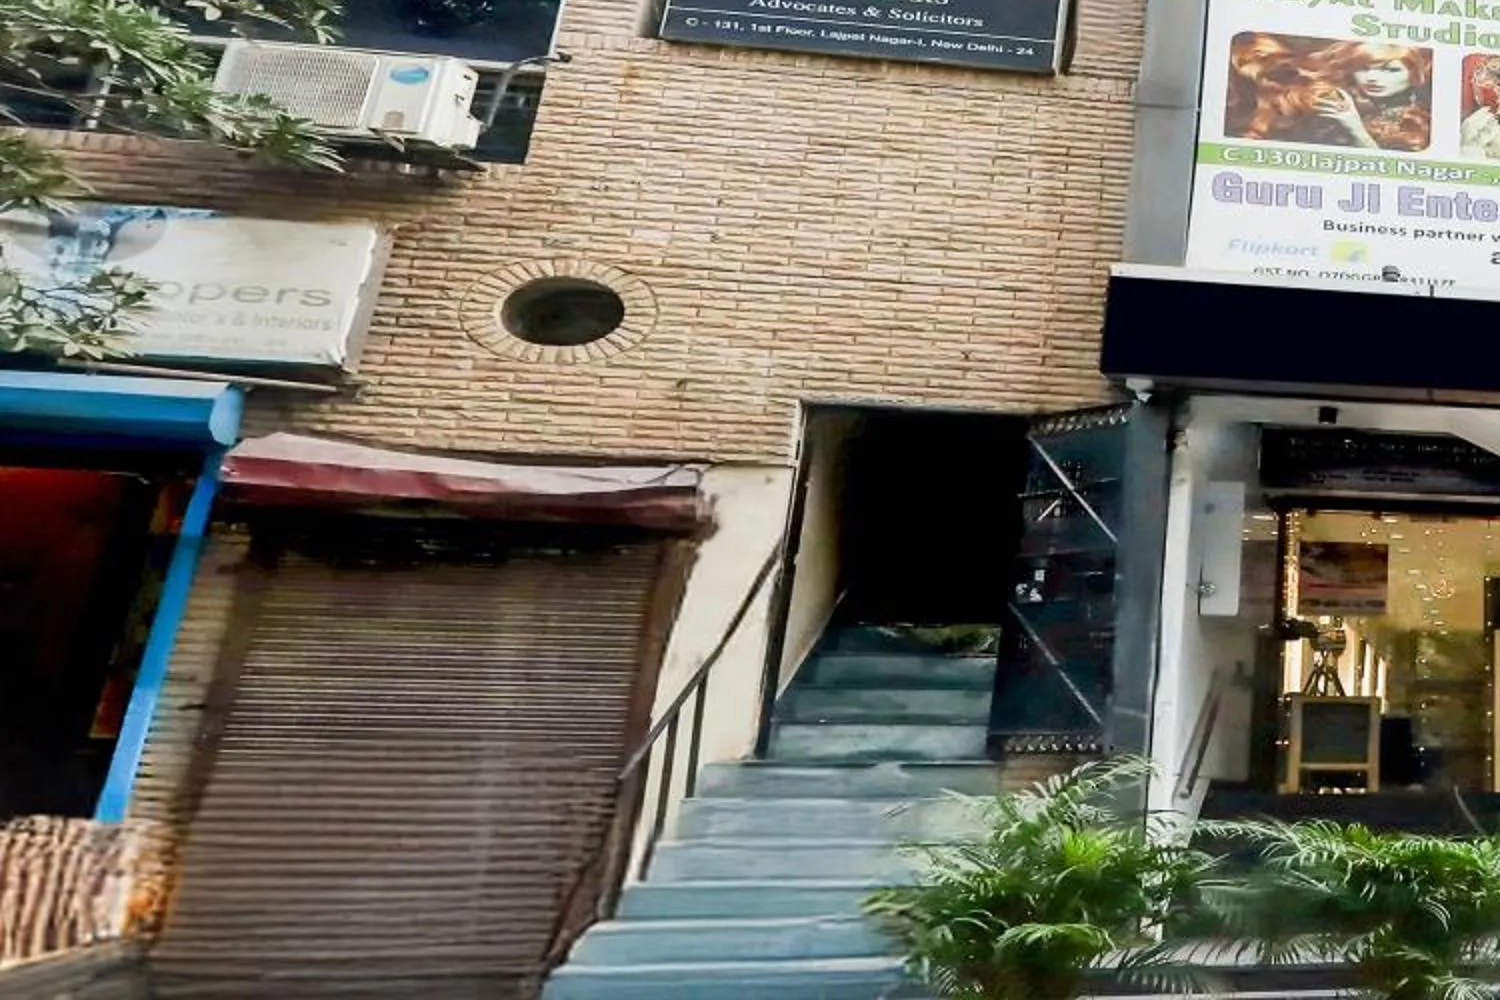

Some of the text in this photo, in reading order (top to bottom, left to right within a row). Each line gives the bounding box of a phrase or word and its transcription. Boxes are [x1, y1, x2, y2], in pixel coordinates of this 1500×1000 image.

[862, 5, 882, 19] &
[887, 7, 985, 28] Solicitors
[751, 22, 771, 33] 1st
[820, 29, 866, 42] Lajpat
[931, 38, 963, 50] New
[967, 42, 1003, 53] Delhi
[1222, 146, 1240, 161] C
[1397, 159, 1475, 182] Nagar
[1211, 171, 1323, 209] Guru
[1323, 219, 1408, 237] Business
[1413, 225, 1486, 243] partner
